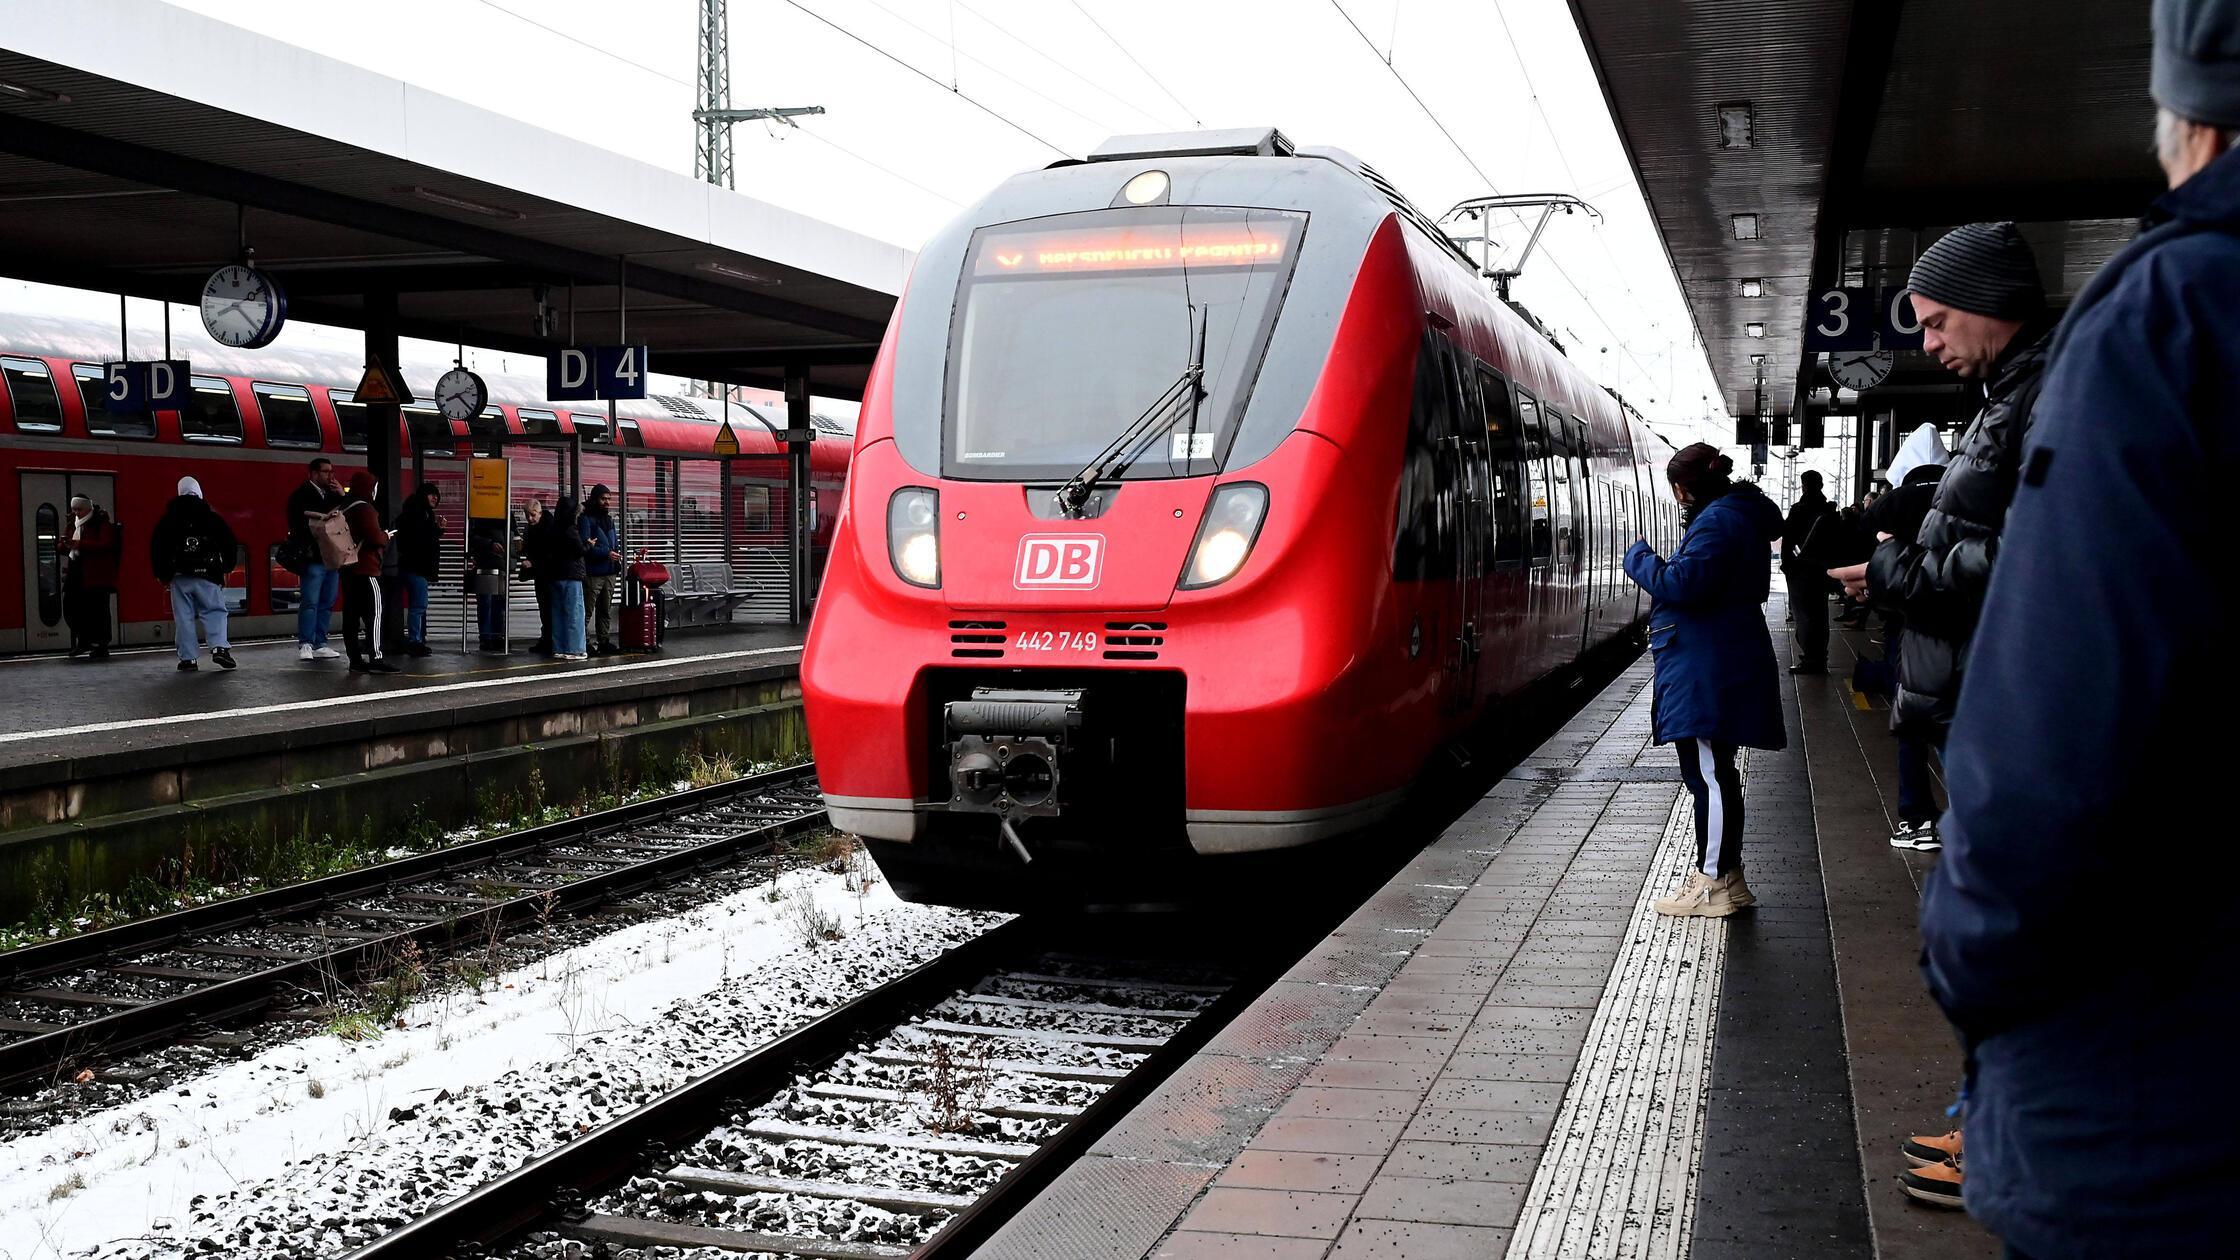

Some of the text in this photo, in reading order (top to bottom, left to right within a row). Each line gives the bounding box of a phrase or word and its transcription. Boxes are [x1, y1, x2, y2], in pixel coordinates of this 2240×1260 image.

[1817, 290, 1849, 337] 3
[109, 362, 174, 401] 5 D
[561, 347, 639, 388] D 4
[1024, 542, 1093, 581] DB
[1015, 631, 1097, 652] 442 749
